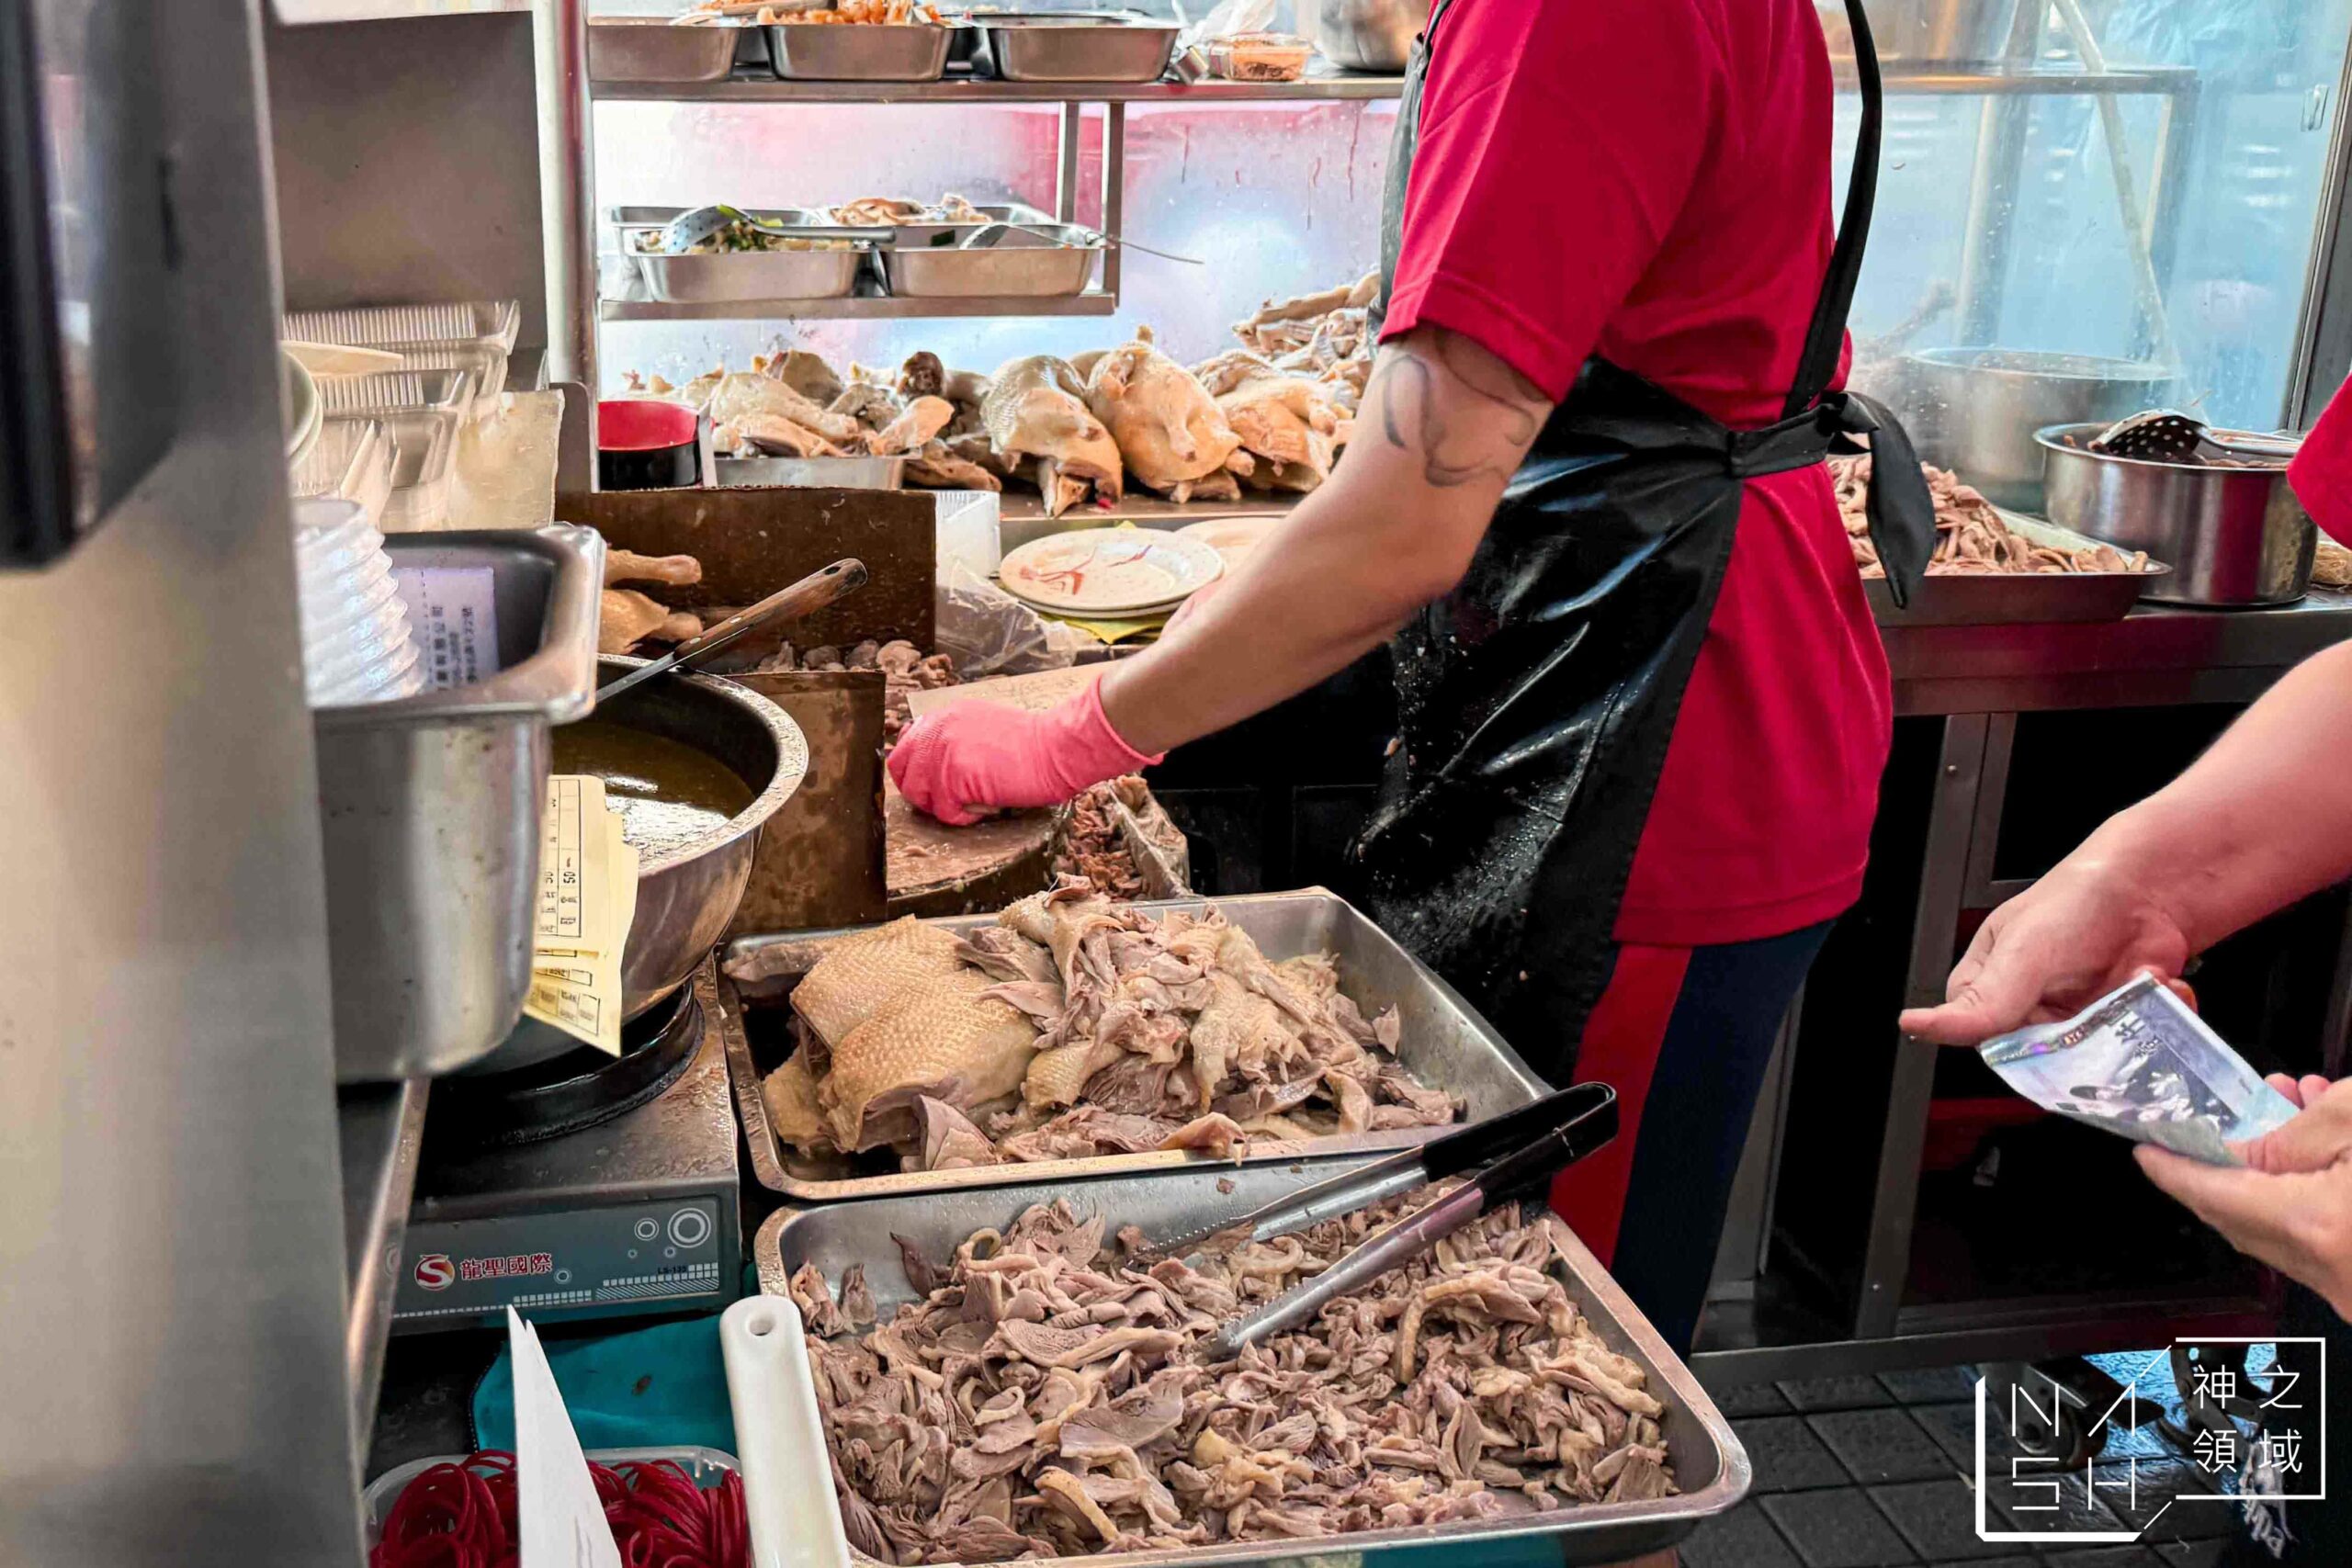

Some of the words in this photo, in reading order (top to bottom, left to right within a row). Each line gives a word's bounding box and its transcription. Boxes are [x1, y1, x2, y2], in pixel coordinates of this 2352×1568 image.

[562, 871, 576, 884] 50
[459, 1252, 553, 1280] 龍聖國際
